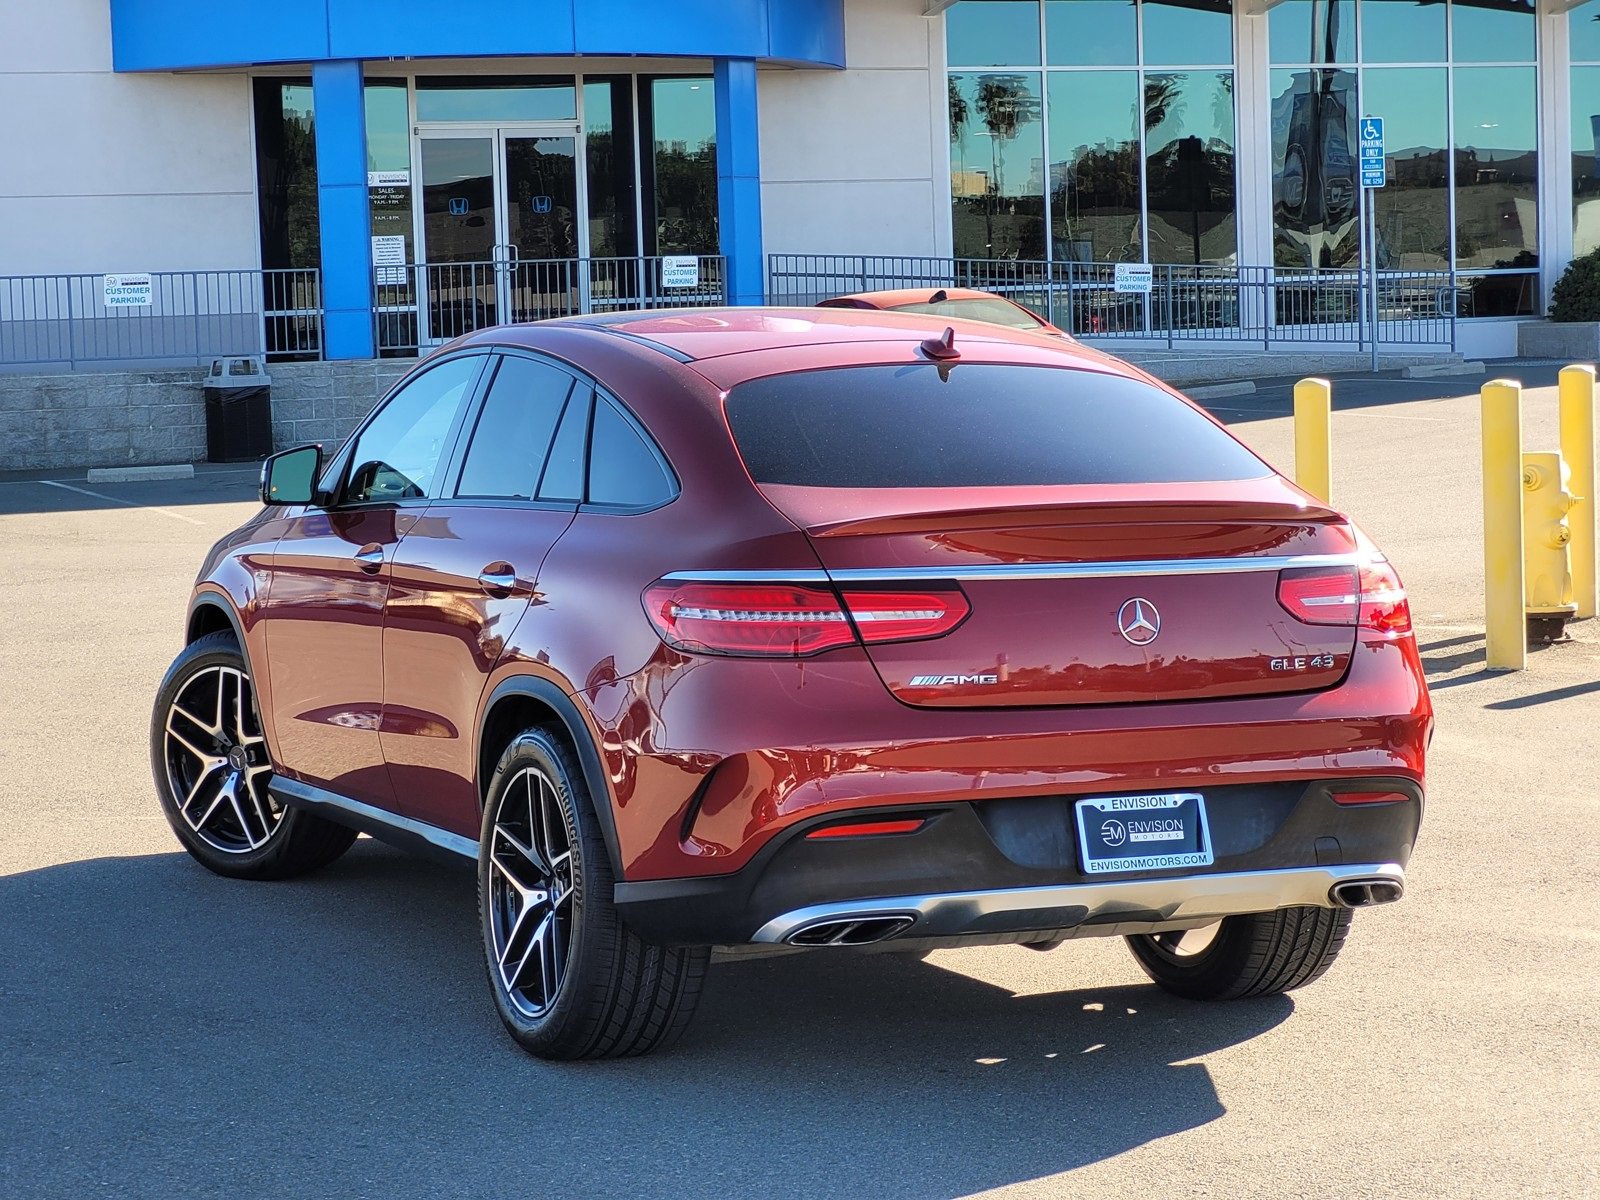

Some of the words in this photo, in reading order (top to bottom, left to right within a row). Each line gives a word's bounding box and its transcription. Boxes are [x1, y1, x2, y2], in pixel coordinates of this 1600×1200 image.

[1361, 140, 1382, 148] PARKING
[1365, 149, 1378, 157] ONLY
[1270, 658, 1306, 670] GLE
[1311, 655, 1334, 668] 43
[938, 675, 997, 685] AMG
[1112, 797, 1167, 809] ENVISION
[1128, 819, 1184, 833] ENVISION
[1091, 855, 1207, 871] ENVISIONMOTORS.COM
